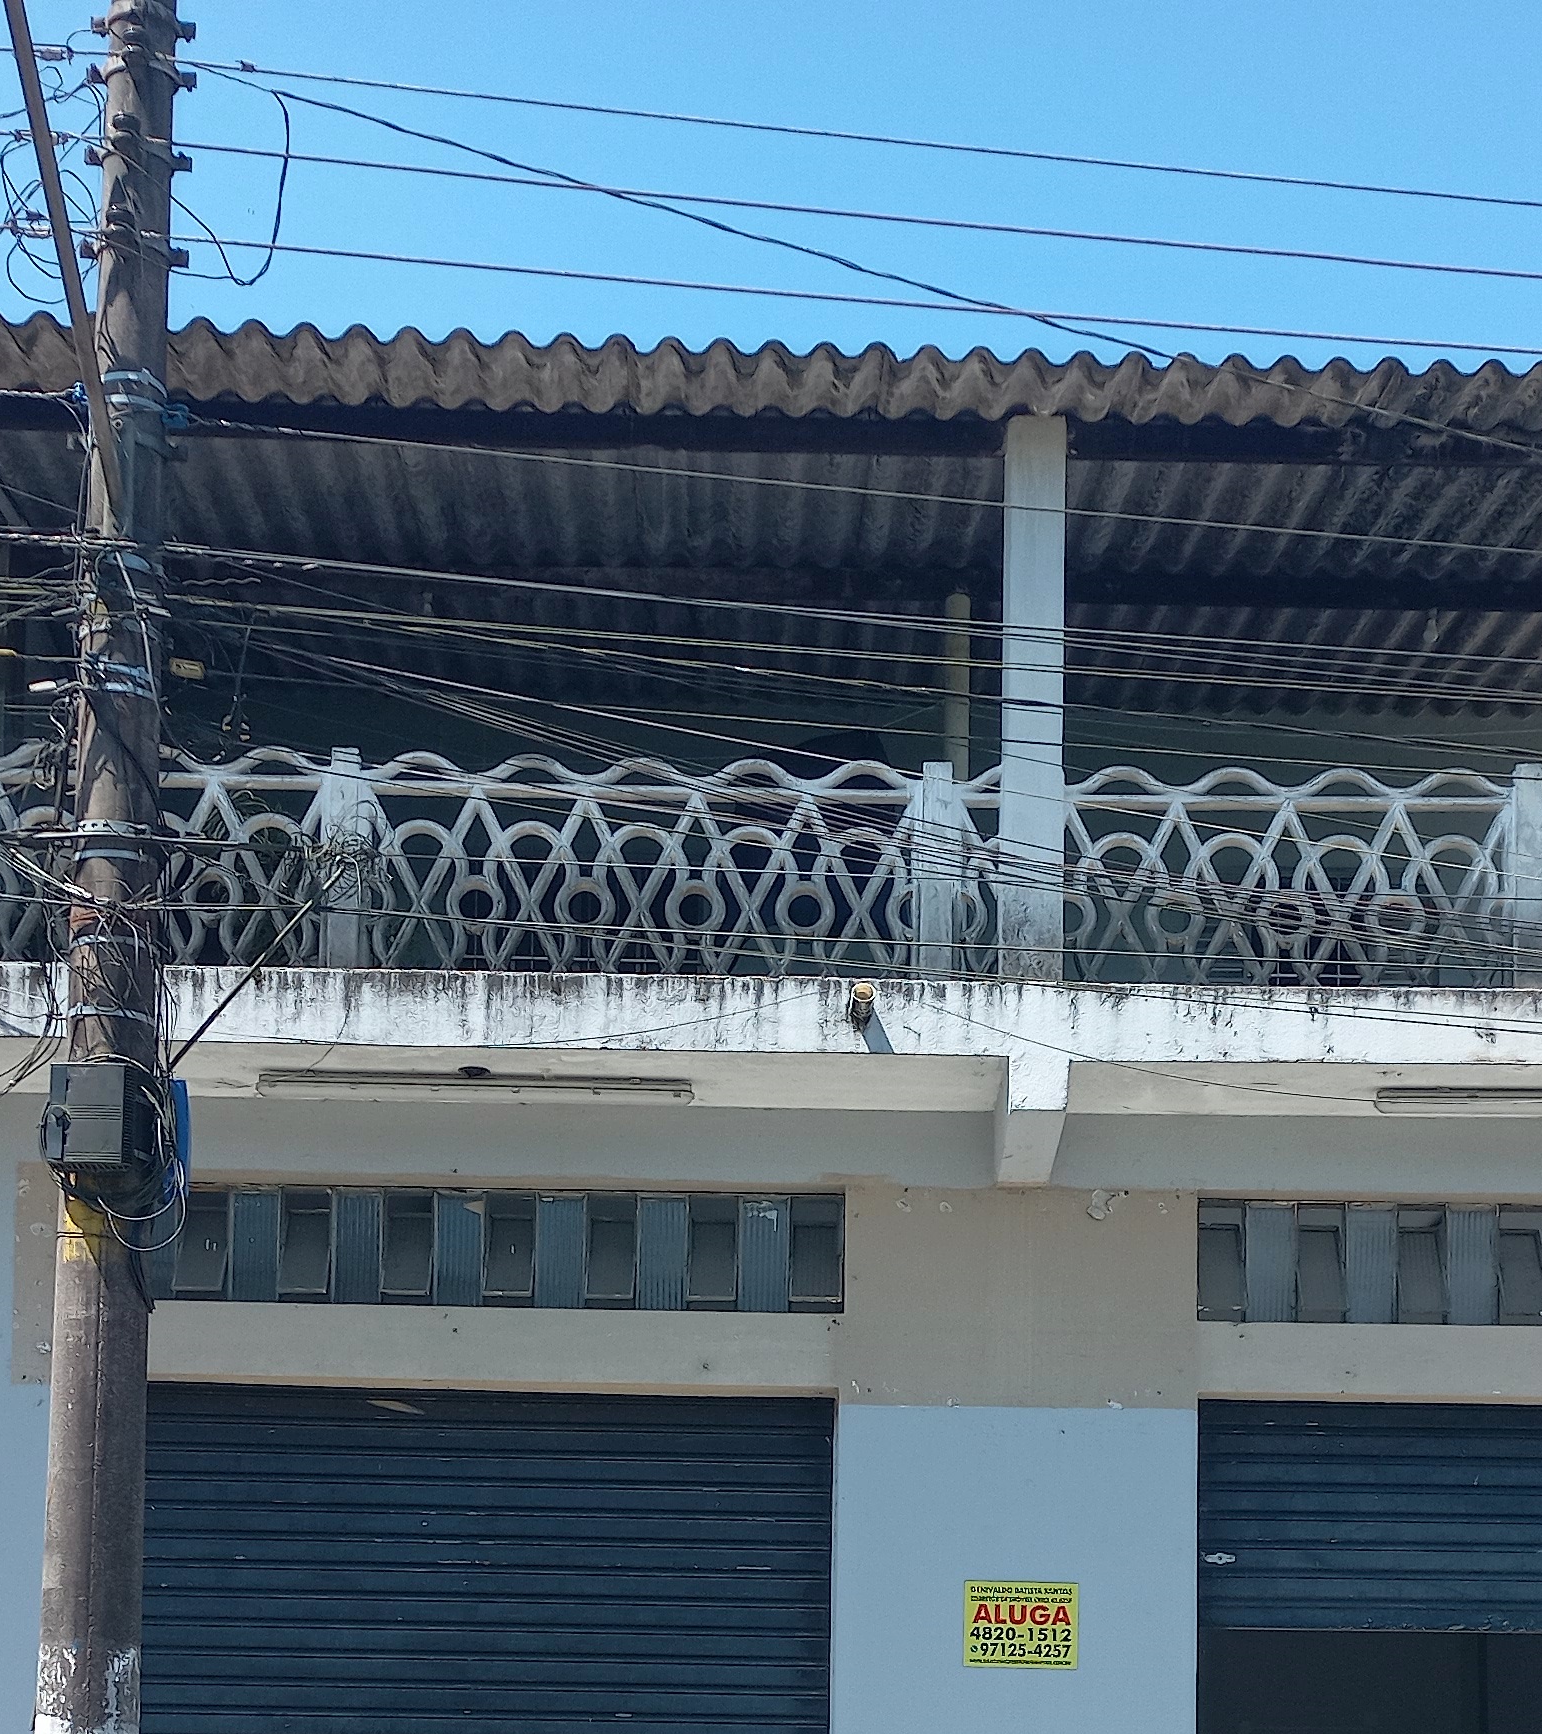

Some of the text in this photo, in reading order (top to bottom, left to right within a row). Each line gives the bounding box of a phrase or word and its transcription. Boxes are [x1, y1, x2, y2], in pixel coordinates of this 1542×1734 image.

[972, 1604, 1071, 1626] ALUGA
[970, 1626, 1072, 1642] 4820-1512
[980, 1642, 1072, 1658] 97125-4257
